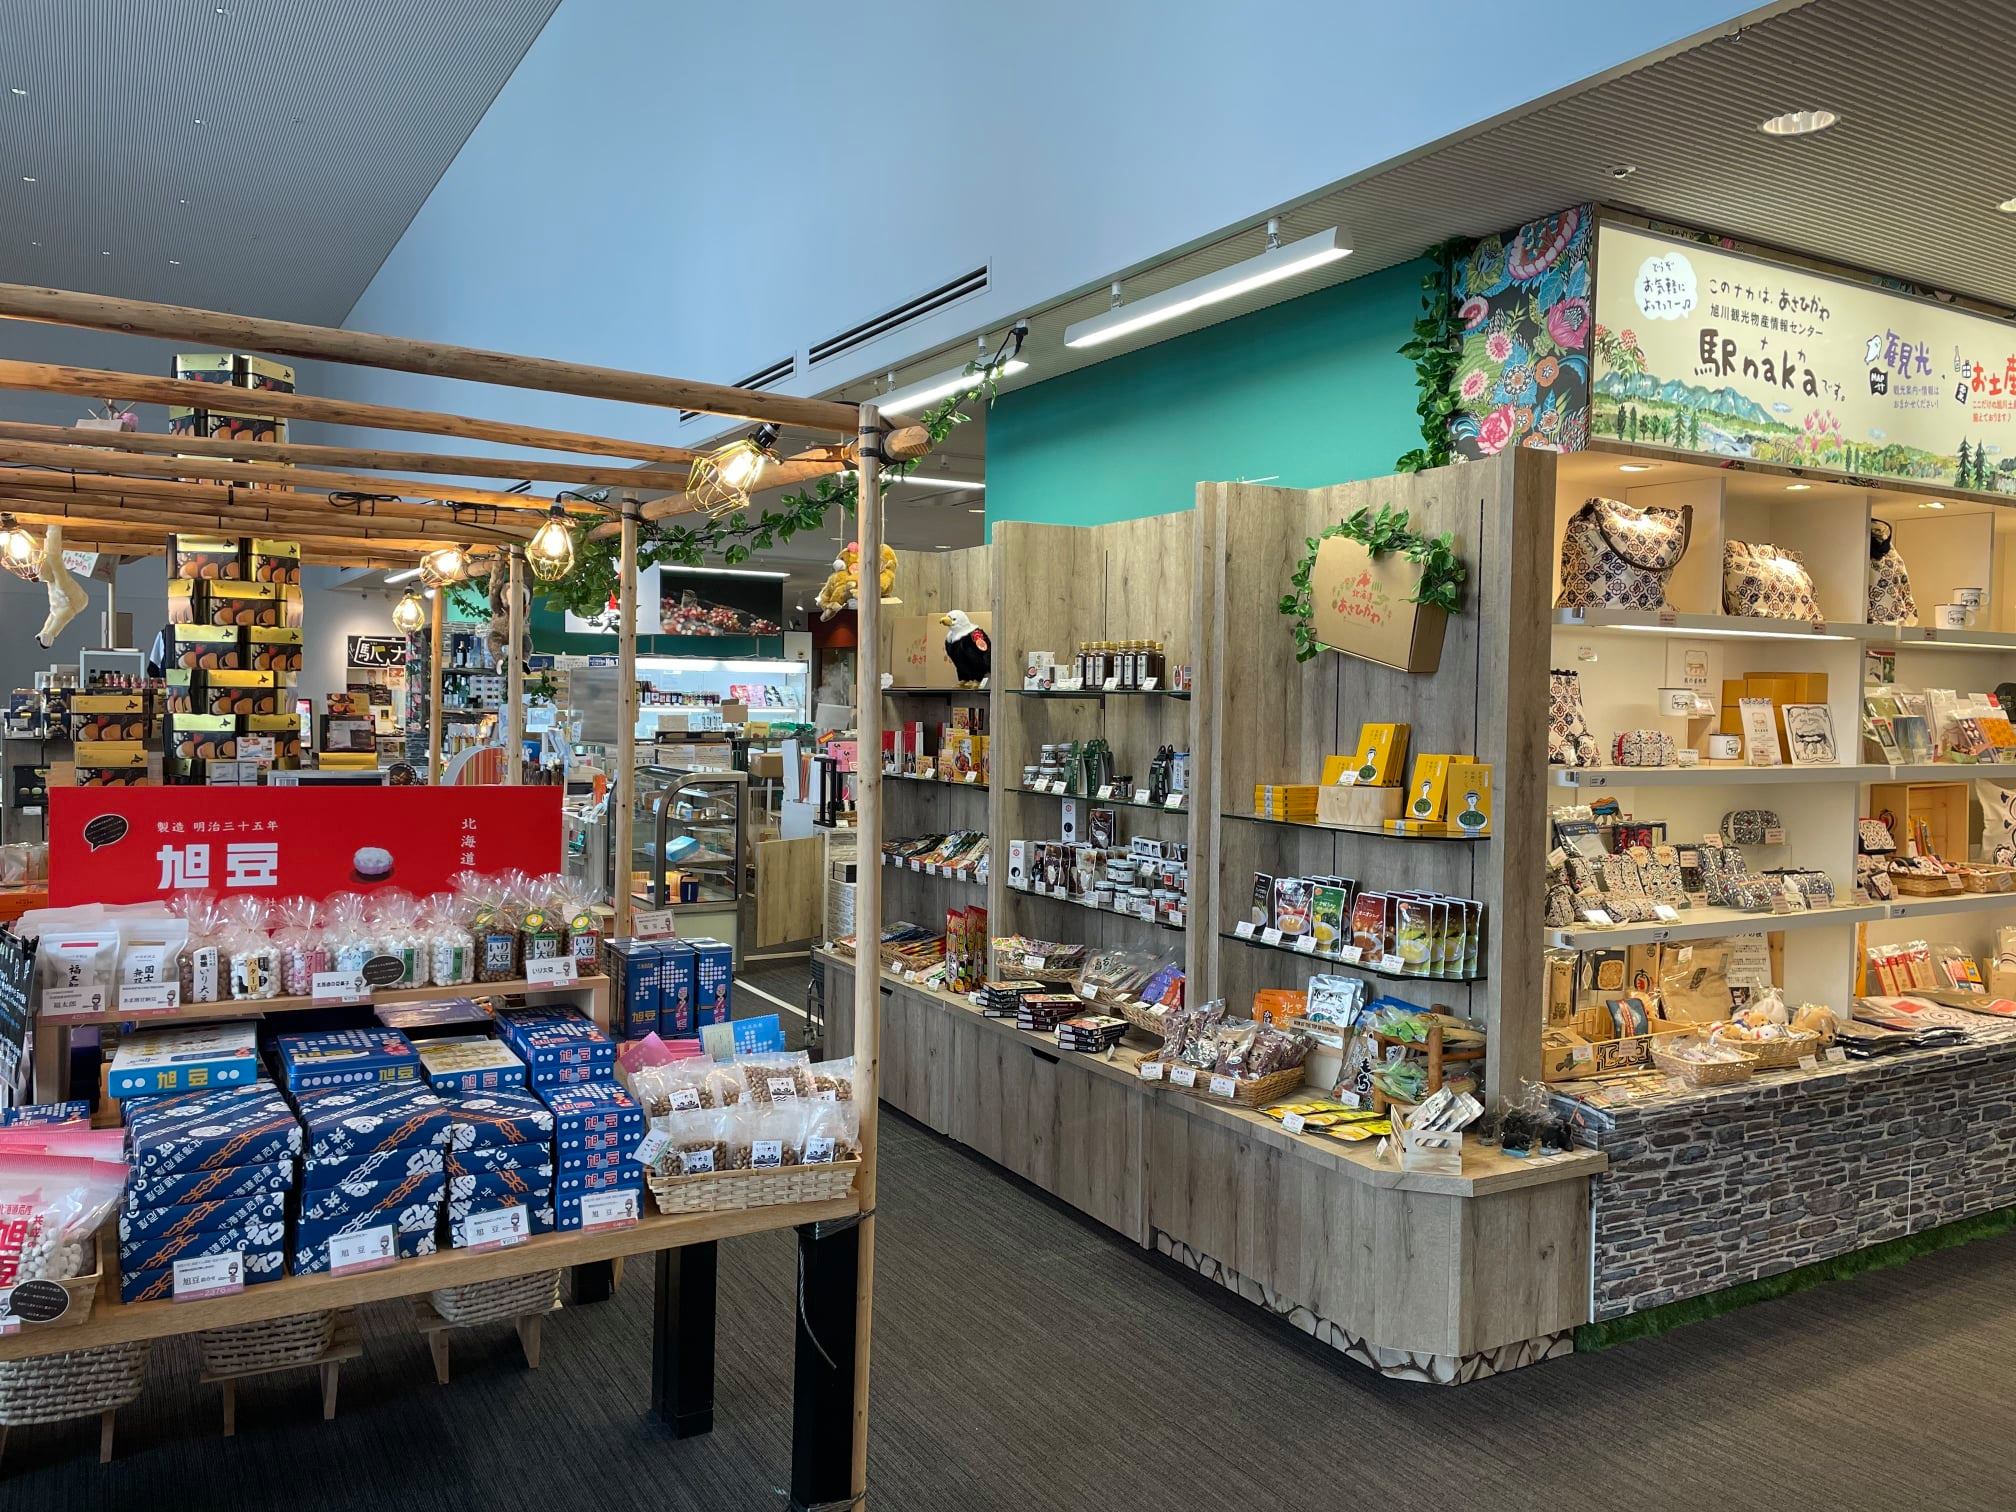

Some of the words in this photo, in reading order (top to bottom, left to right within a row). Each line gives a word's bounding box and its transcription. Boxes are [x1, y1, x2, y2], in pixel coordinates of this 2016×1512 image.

[1652, 261, 1675, 272] どうぞ
[1643, 278, 1686, 296] お気軽に
[1710, 302, 1824, 338] 旭川観光物産情報センター
[1337, 597, 1381, 625] あさひかわ
[157, 821, 185, 834] 製造
[193, 820, 279, 833] 明治三十五年
[460, 816, 477, 867] 北海道
[156, 842, 279, 889] 旭豆
[489, 942, 510, 953] いり
[536, 940, 556, 951] いり
[575, 937, 595, 947] いり
[488, 953, 510, 963] 大豆
[576, 947, 596, 957] 大豆
[248, 960, 258, 993] バター豆
[632, 1010, 656, 1023] 旭豆
[560, 1048, 590, 1063] 旭豆
[157, 1068, 208, 1089] 旭豆
[378, 1065, 414, 1082] 旭豆
[461, 1072, 498, 1090] 旭豆
[559, 1066, 590, 1082] 旭豆
[584, 1114, 618, 1131] 旭豆
[584, 1132, 618, 1150] 旭豆
[587, 1151, 620, 1170] 旭豆
[584, 1171, 618, 1189] 旭豆
